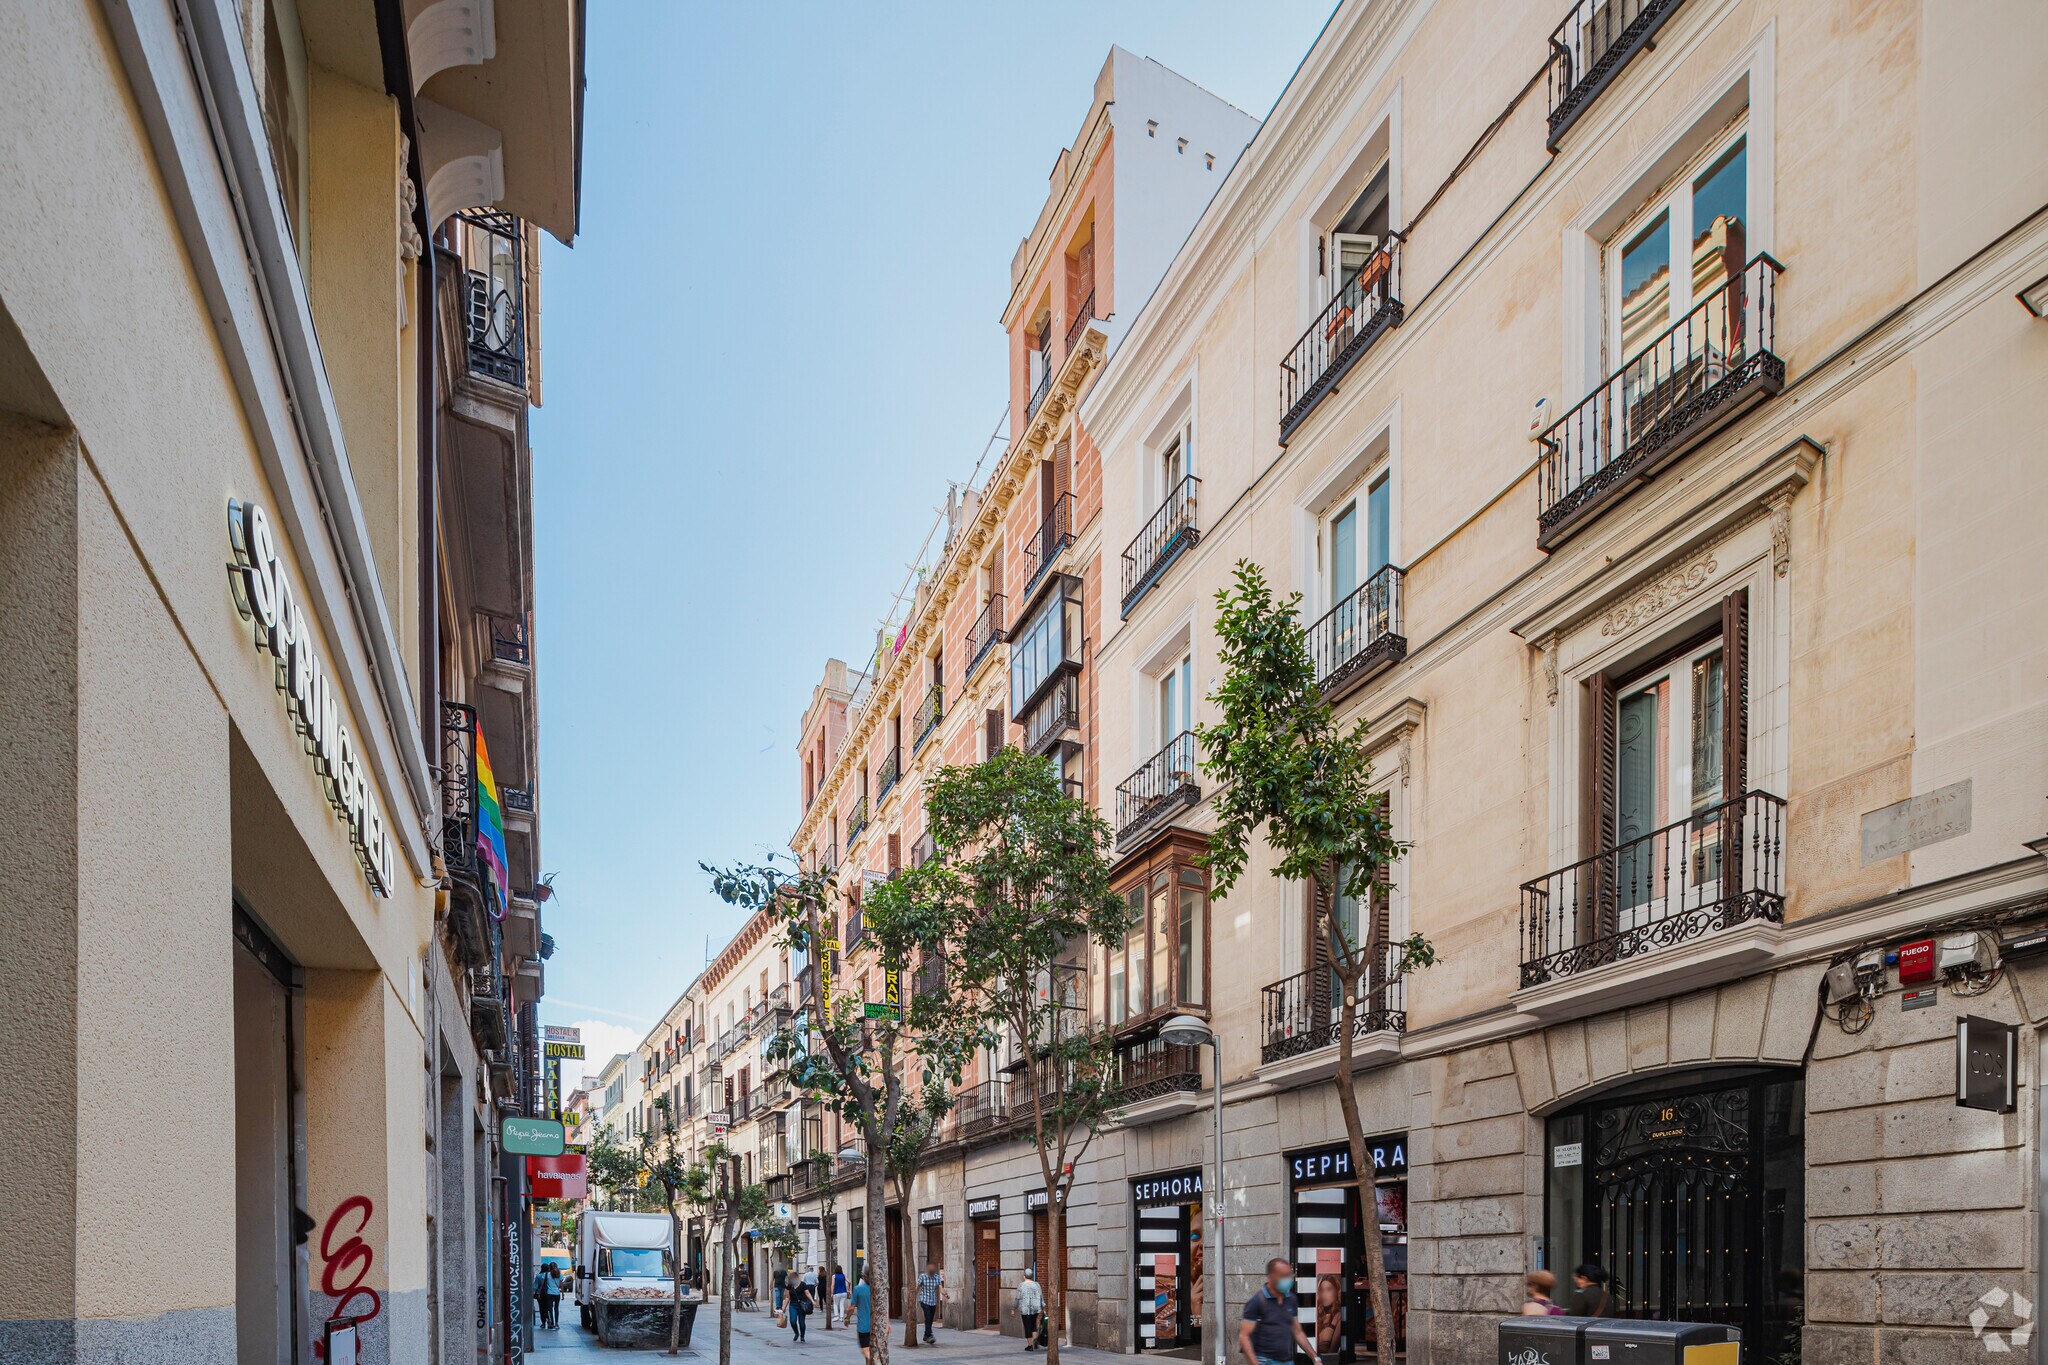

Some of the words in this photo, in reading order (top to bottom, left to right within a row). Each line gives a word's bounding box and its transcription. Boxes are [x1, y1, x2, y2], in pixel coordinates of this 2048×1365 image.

[240, 501, 395, 900] SPRINGFIELD
[1901, 945, 1930, 957] FUEGO
[546, 1026, 571, 1036] HOSTAL
[546, 1043, 584, 1059] HOSTAL
[1970, 1050, 2004, 1078] COS
[1661, 1108, 1674, 1121] 16
[506, 1125, 530, 1140] Pepe
[530, 1128, 560, 1141] Jeans
[1652, 1129, 1683, 1138] DUPLICADO
[1294, 1145, 1405, 1179] SEPHRA
[537, 1170, 581, 1181] havaianas
[1136, 1175, 1202, 1200] SEPHORA
[969, 1199, 996, 1217] pimkie
[921, 1209, 942, 1224] pimkie
